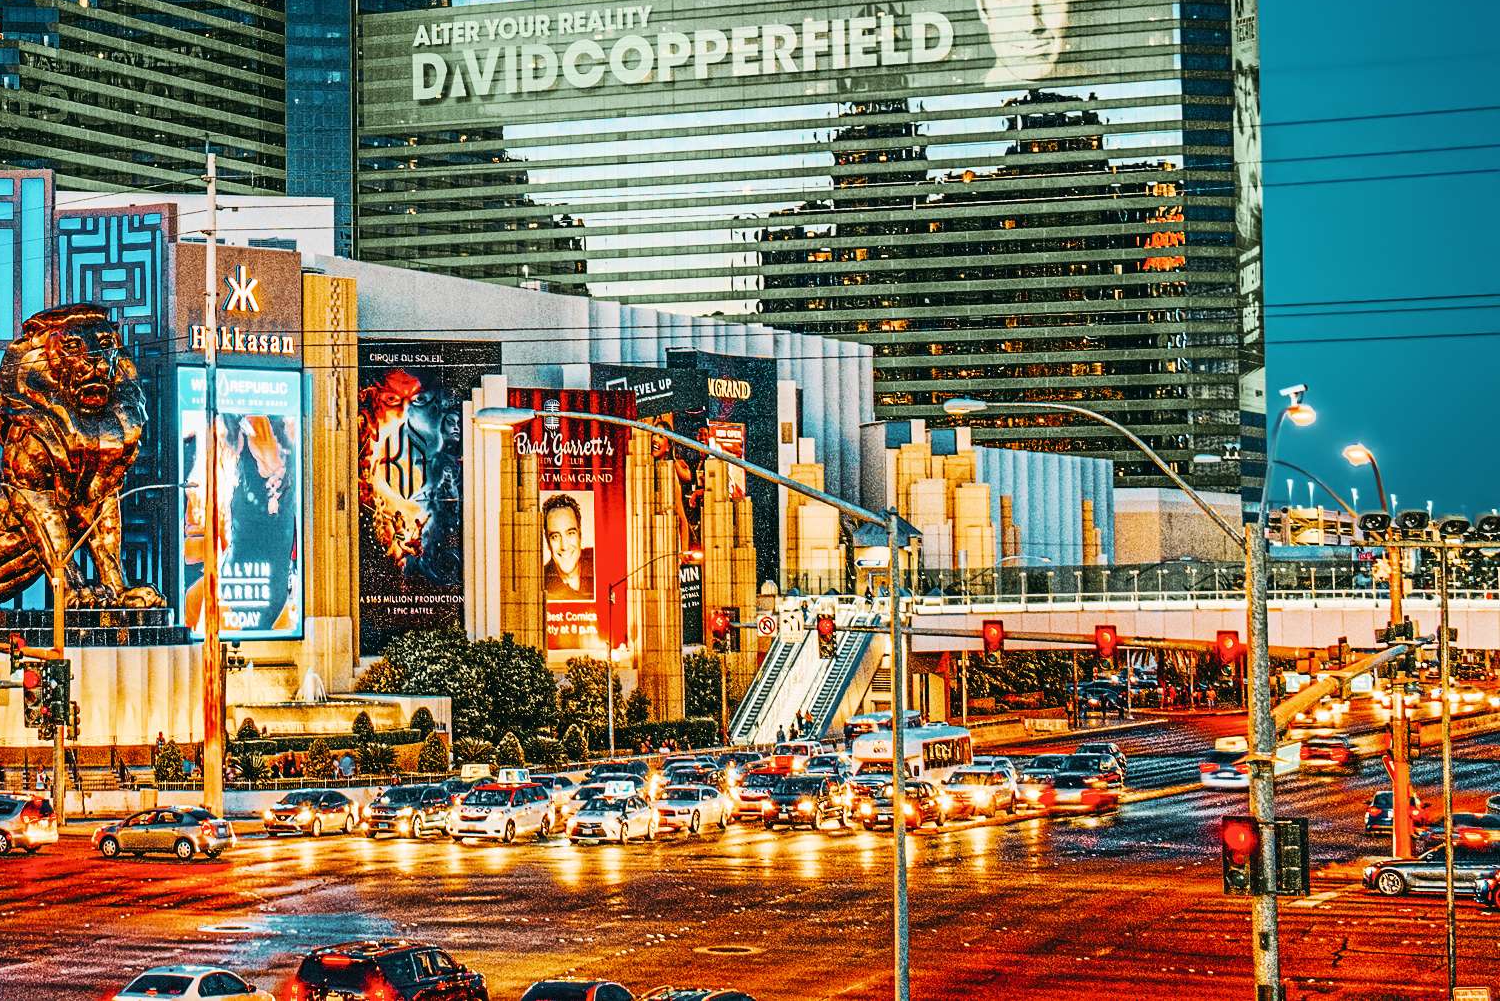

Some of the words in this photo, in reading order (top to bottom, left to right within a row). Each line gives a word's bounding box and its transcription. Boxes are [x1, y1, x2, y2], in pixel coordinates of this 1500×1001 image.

[413, 18, 480, 47] ALTER
[484, 12, 550, 41] YOUR
[558, 5, 652, 34] REALITY
[369, 353, 399, 364] CIRQUE
[400, 354, 413, 362] DU
[415, 354, 444, 363] SOLEIL
[230, 380, 288, 394] REPUBLIC
[658, 378, 672, 390] UP
[715, 380, 751, 399] GRAND
[514, 432, 549, 455] Brad
[552, 431, 614, 466] Garrett's
[540, 473, 551, 482] AT
[552, 473, 576, 482] MGM
[577, 473, 613, 483] GRAND
[223, 562, 270, 577] ALVIN
[223, 584, 270, 600] ARRIS
[383, 595, 413, 603] MILLION
[415, 595, 465, 603] PRODUCTION
[410, 607, 434, 615] BATTLE
[222, 611, 261, 627] TODAY
